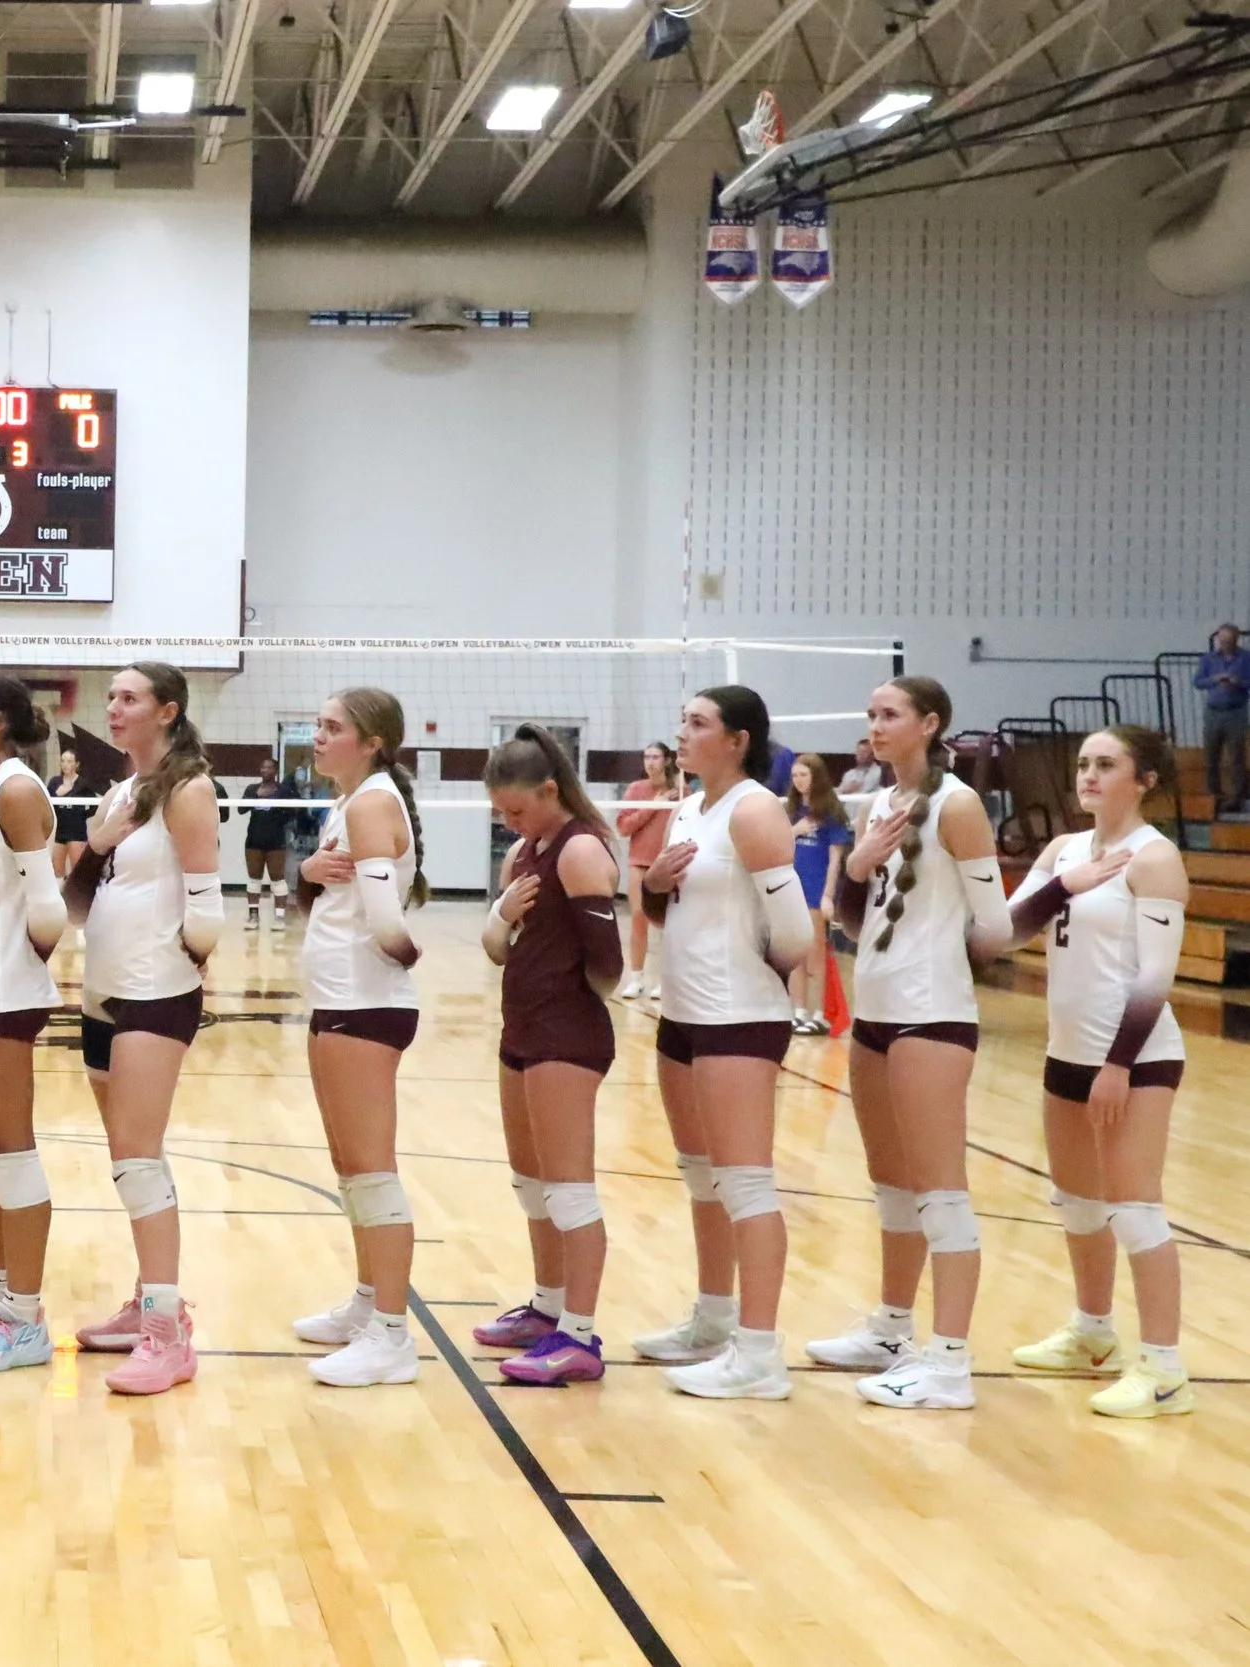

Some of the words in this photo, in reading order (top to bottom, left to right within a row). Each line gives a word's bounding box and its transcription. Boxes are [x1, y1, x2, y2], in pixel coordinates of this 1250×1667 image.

[77, 414, 100, 448] 0
[12, 441, 29, 467] 3
[37, 473, 112, 491] fouls-player
[37, 525, 68, 541] team
[22, 637, 49, 645] OWEN
[54, 637, 112, 645] VOLLEYBALL
[124, 638, 151, 646] OWEN
[156, 638, 214, 647] VOLLEYBALL
[258, 639, 316, 647] VOLLEYBALL
[328, 639, 356, 647] OWEN
[360, 639, 419, 648] VOLLEYBALL
[430, 640, 458, 648] OWEN
[463, 640, 521, 649] VOLLEYBALL
[534, 640, 561, 648] OWEN
[565, 640, 624, 649] VOLLEYBALL
